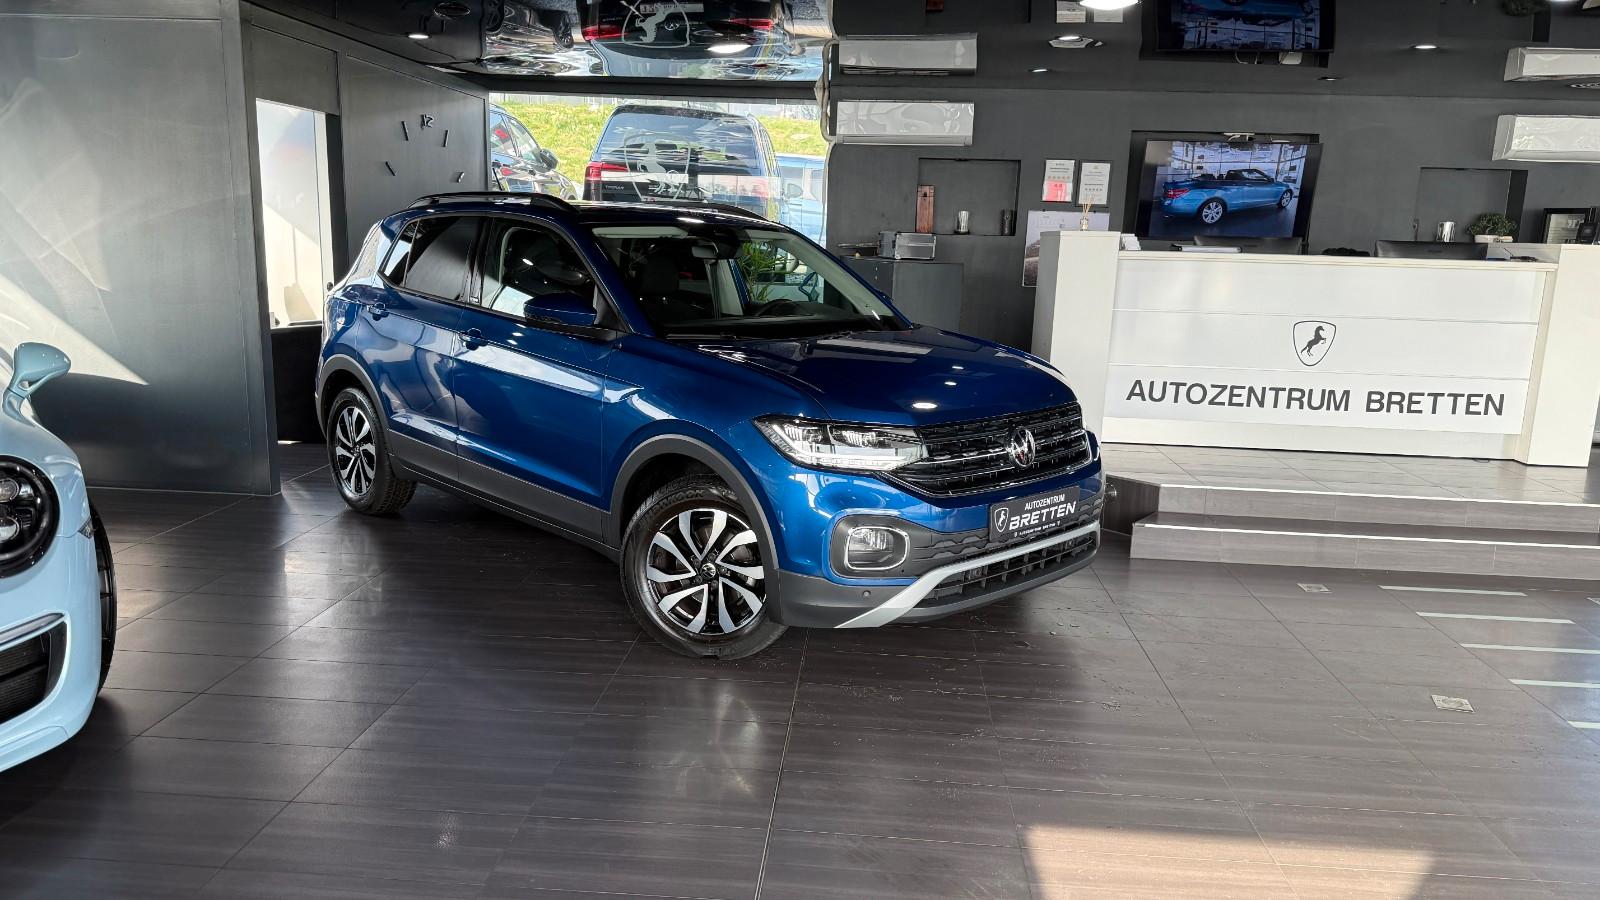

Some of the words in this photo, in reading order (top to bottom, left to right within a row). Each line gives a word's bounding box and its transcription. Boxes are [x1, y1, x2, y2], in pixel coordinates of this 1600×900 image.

[1126, 379, 1350, 411] AUTOZENTRUM
[1365, 390, 1504, 415] BRETTEN
[1009, 501, 1077, 531] BRETTEN
[1024, 494, 1065, 510] AUTOZENTRUM
